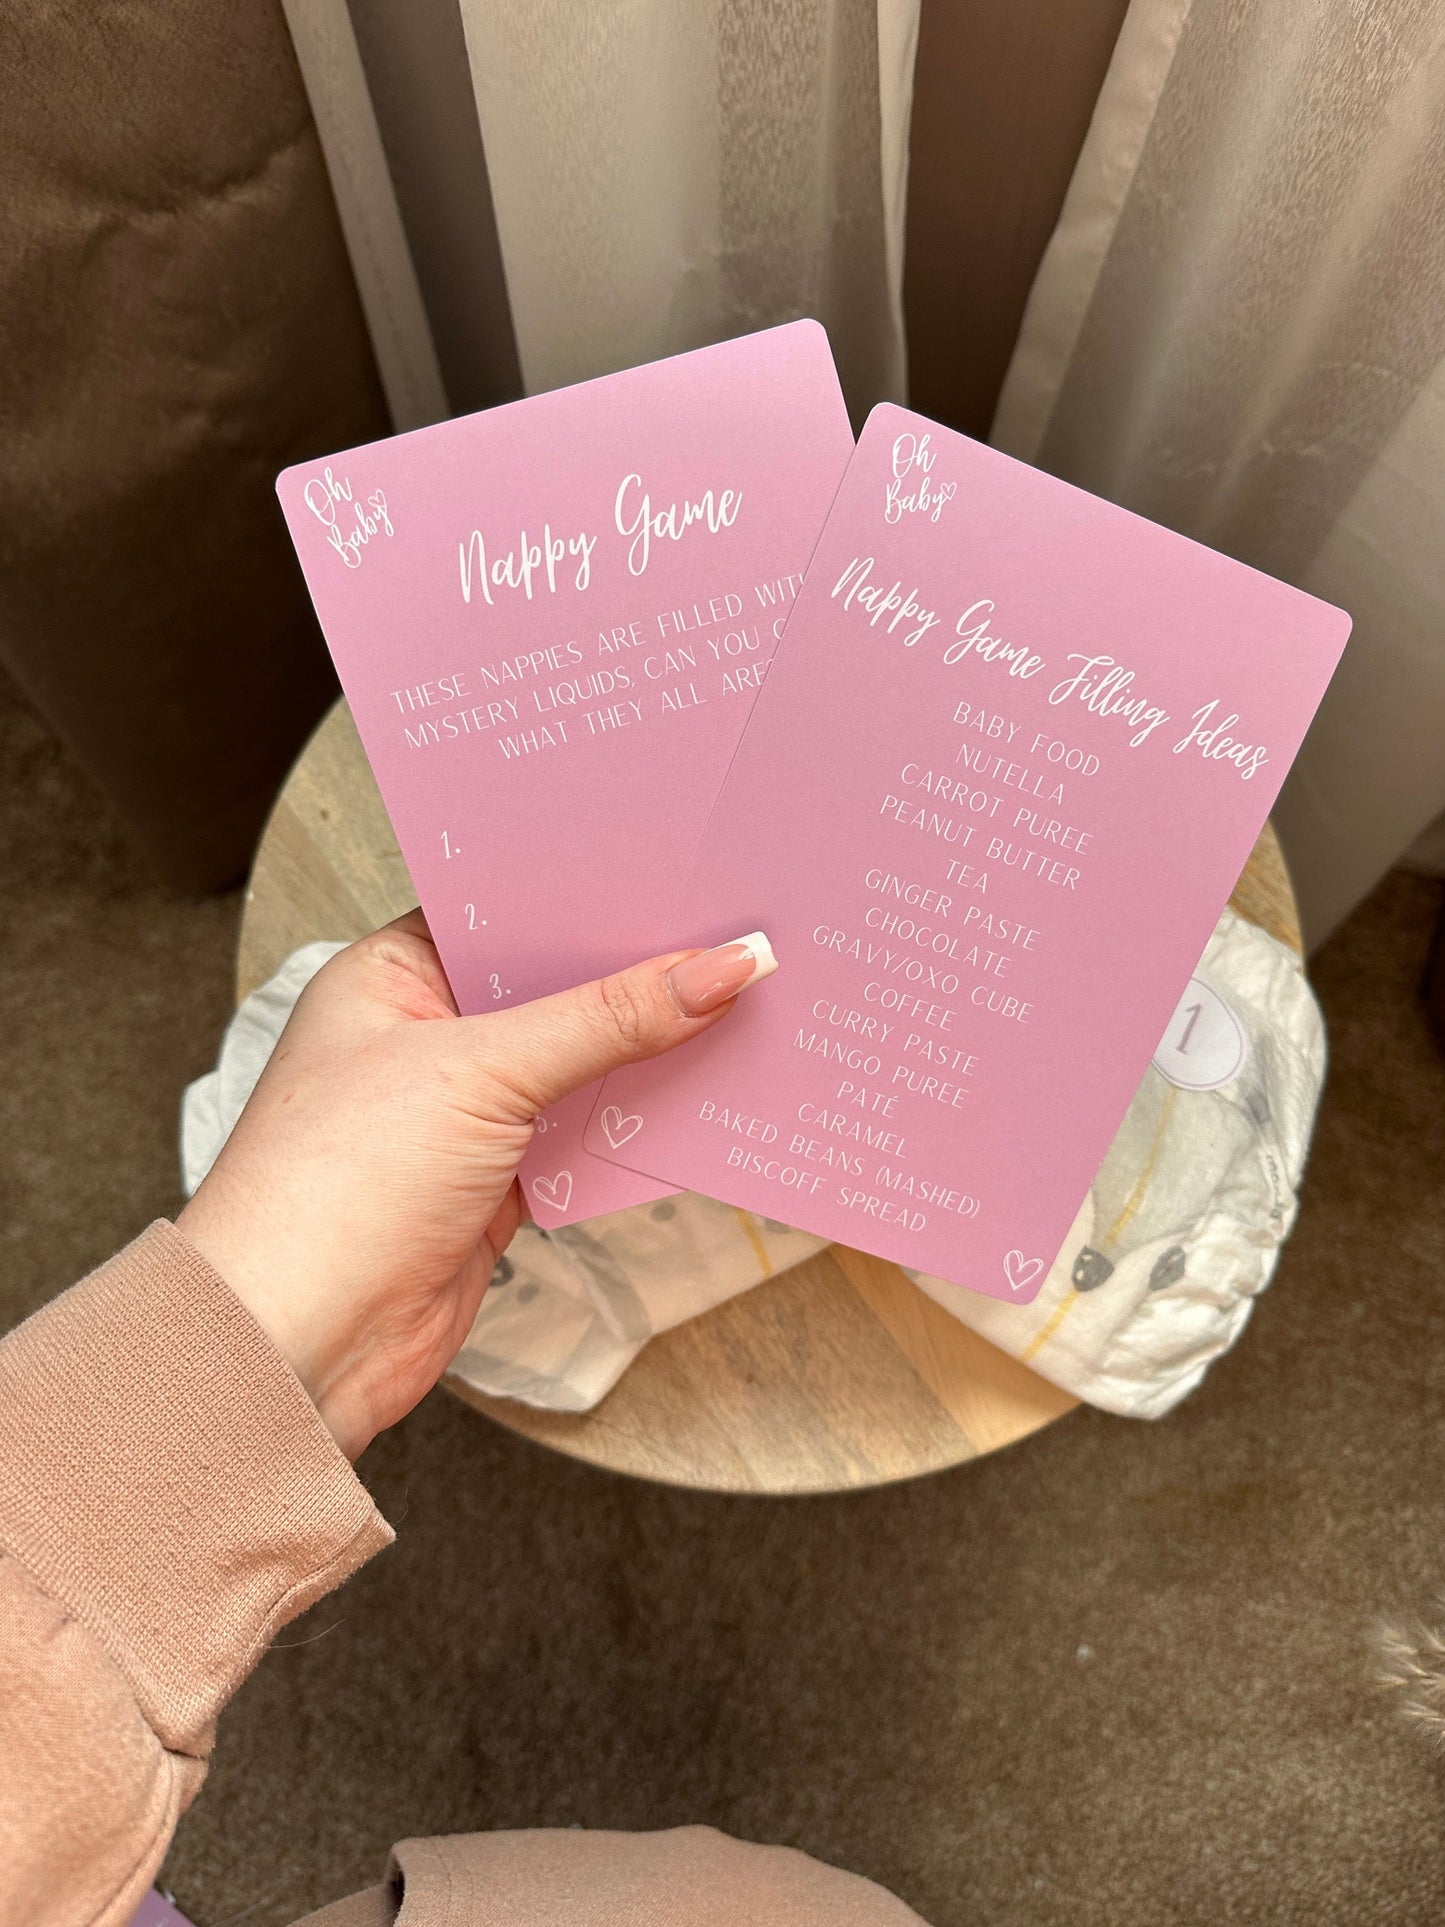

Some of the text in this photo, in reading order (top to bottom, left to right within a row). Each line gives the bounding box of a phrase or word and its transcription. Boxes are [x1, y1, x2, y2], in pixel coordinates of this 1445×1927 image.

[892, 433, 938, 479] Oh
[304, 466, 352, 526] Oh
[885, 477, 948, 524] Baby
[326, 501, 394, 569] Baby
[459, 473, 743, 605] Nappy Game
[390, 673, 471, 713] THESE
[481, 641, 582, 689] NAPPIES
[599, 622, 646, 656] ARE
[657, 594, 742, 637] FILLED
[404, 697, 518, 748] MYSTERY
[533, 666, 635, 712] LIQUIDS,
[644, 646, 696, 679] CAN
[707, 626, 760, 660] YOU
[831, 556, 1269, 780] Nappy Game Filling Ideas
[498, 721, 567, 759] WHAT
[582, 699, 641, 735] THEY
[662, 683, 707, 713] ALL
[953, 701, 1099, 776] BABY FOOD
[901, 764, 1092, 855] CARROT PUREE
[956, 744, 1063, 805] NUTELLA
[441, 830, 461, 859] 1.
[880, 795, 1080, 890] PEANUT BUTTER
[947, 859, 987, 893] TEA
[465, 903, 488, 931] 2.
[865, 869, 1040, 951] GINGER PASTE
[866, 907, 1011, 977] CHOCOLATE
[489, 973, 511, 999] 3.
[813, 925, 1034, 1023] GRAVY/OXO CUBE
[864, 983, 956, 1031] COFFEE
[813, 1000, 978, 1076] CURRY PASTE
[1175, 1003, 1202, 1056] 1
[794, 1029, 968, 1108] MANGO PUREE
[837, 1081, 898, 1118] PATÉ
[699, 1101, 980, 1218] BAKED BEANS (MASHED)
[798, 1103, 905, 1158] CARAMEL
[727, 1146, 926, 1231] BISCOFF SPREAD
